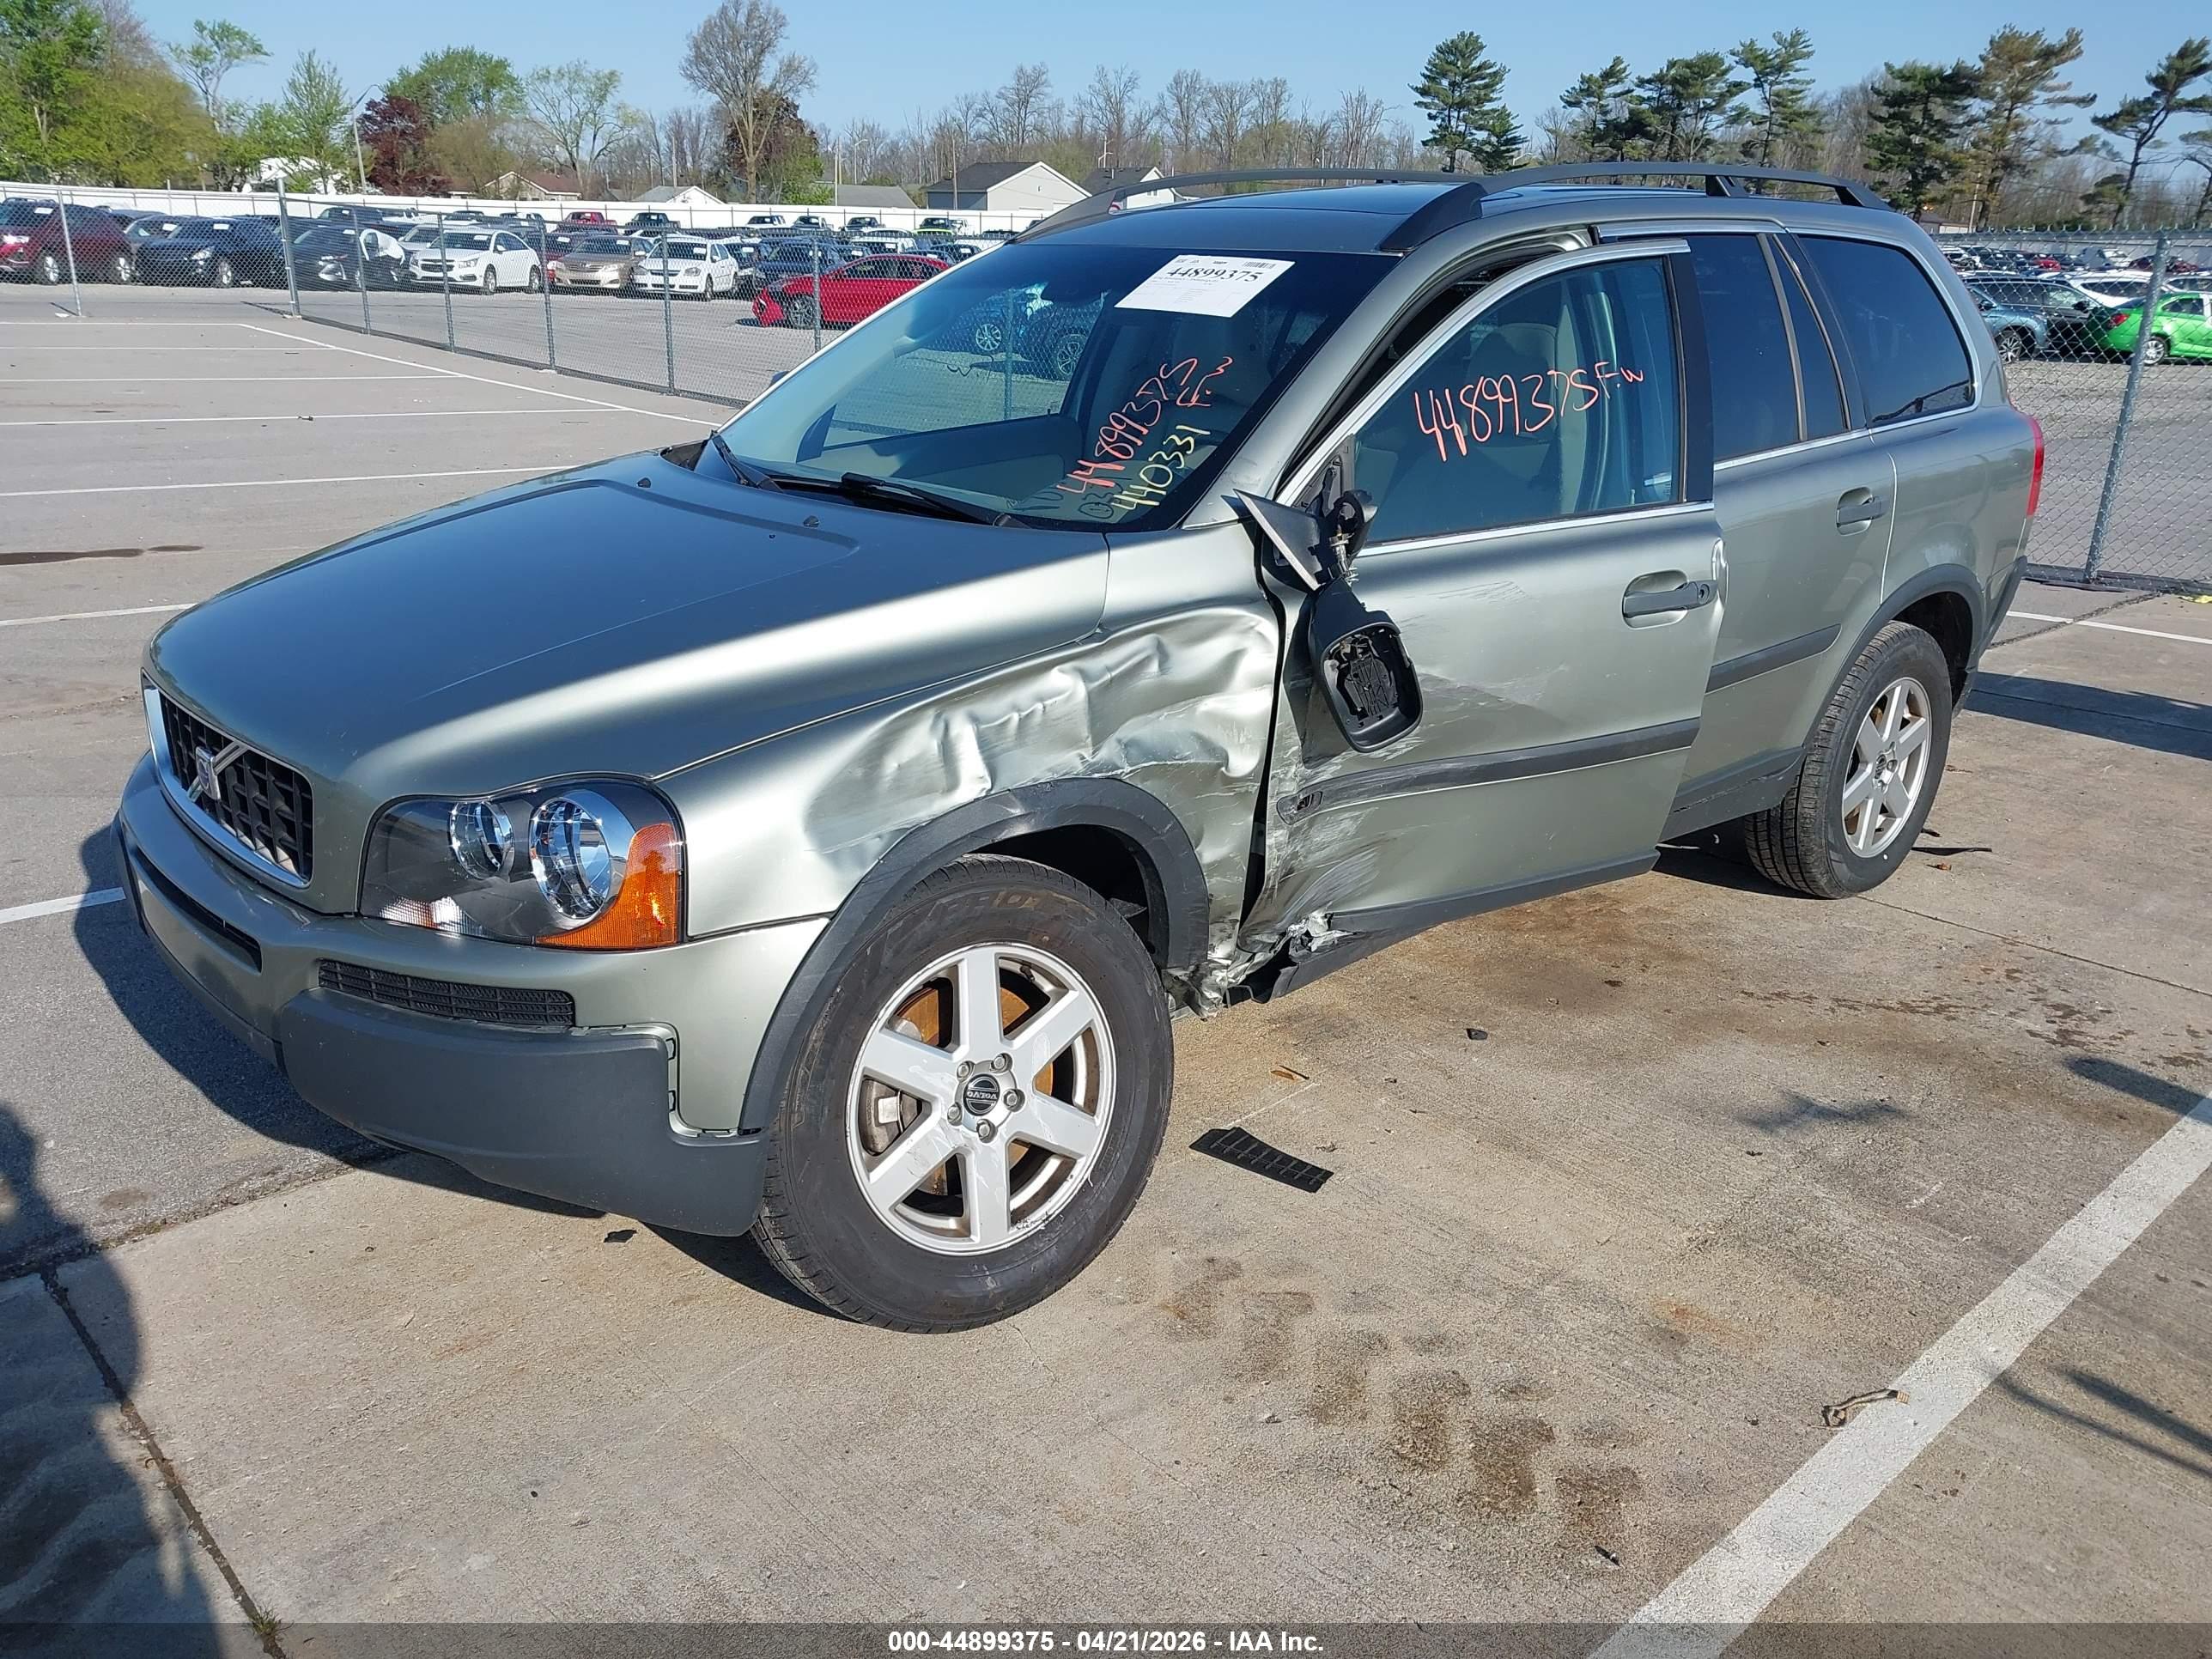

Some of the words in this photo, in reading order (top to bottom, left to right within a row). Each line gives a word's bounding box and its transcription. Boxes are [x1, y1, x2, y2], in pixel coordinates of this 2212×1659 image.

[1167, 266, 1263, 283] 44899375
[1110, 424, 1212, 511] 440331
[966, 1091, 998, 1100] VOLVO
